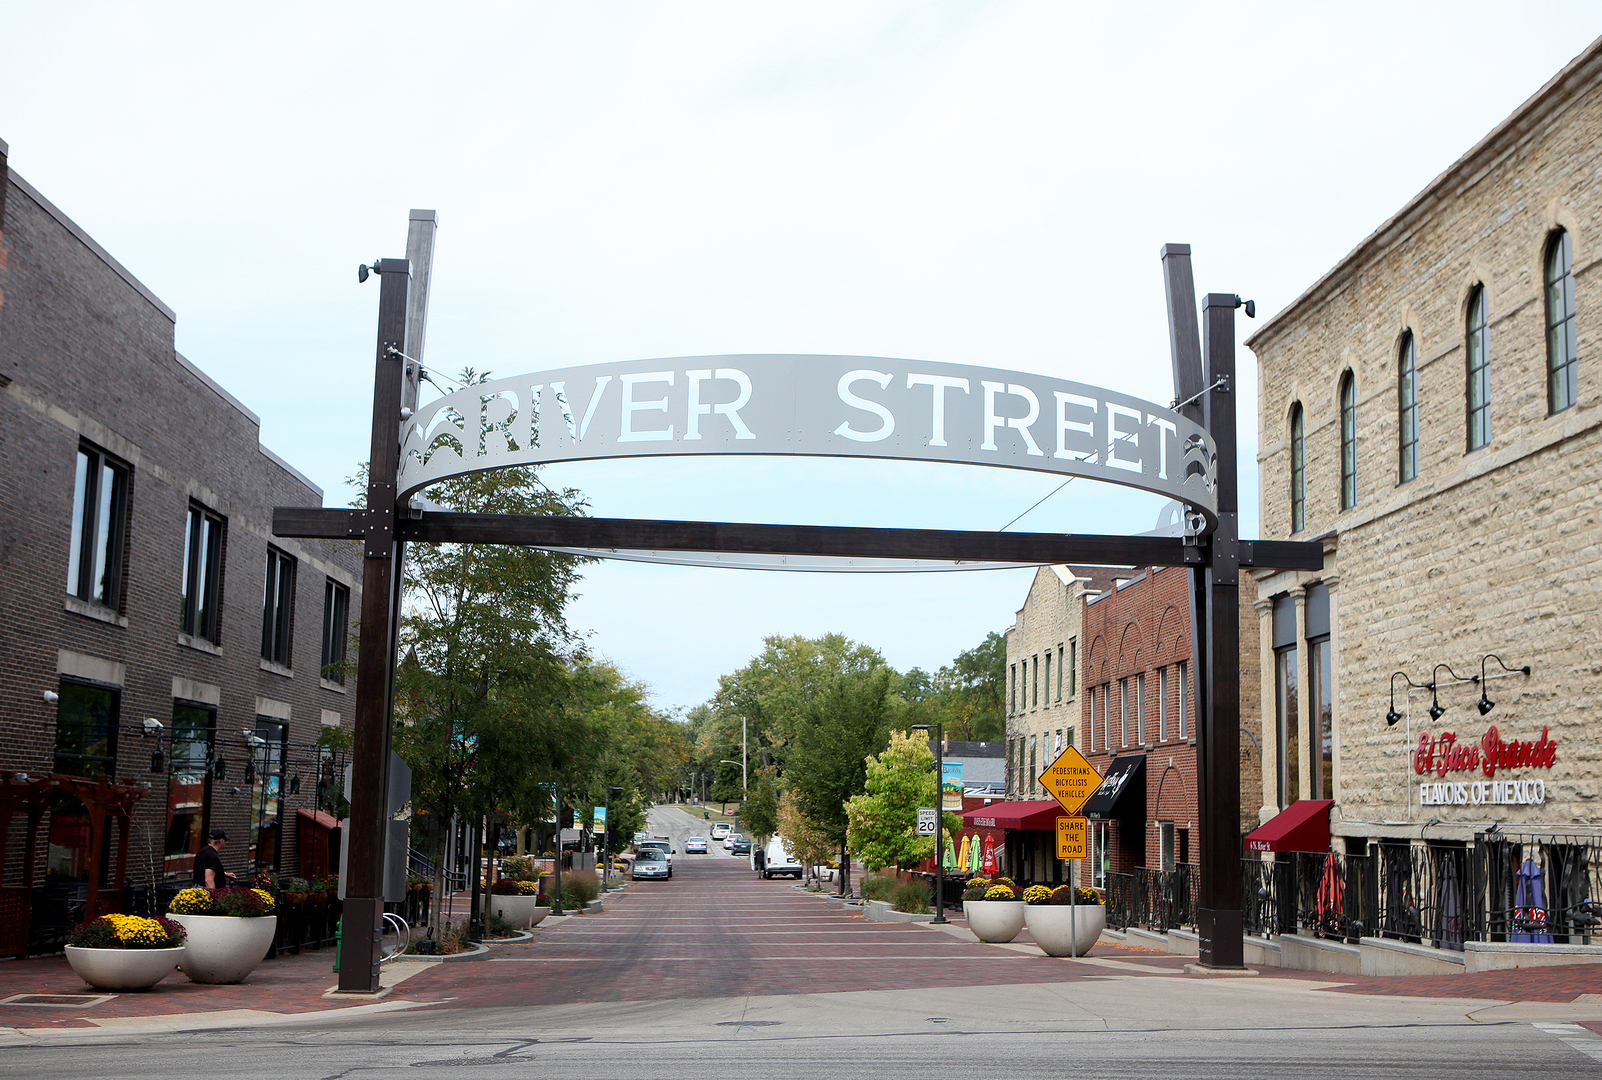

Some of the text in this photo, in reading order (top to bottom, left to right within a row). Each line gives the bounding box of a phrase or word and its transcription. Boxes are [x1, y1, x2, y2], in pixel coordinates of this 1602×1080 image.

[477, 368, 1177, 480] RIVER STREET
[1413, 725, 1557, 777] El Taco Grande
[1052, 767, 1090, 775] PEDESTRIANS
[1055, 778, 1088, 787] BICYCLISTS
[1058, 790, 1085, 798] VEHICLES
[1420, 779, 1546, 806] FLAVORS OF MEXICO
[919, 821, 935, 832] 20
[1059, 822, 1084, 831] SHARE
[1065, 833, 1079, 842] THE
[1062, 845, 1083, 853] ROAD
